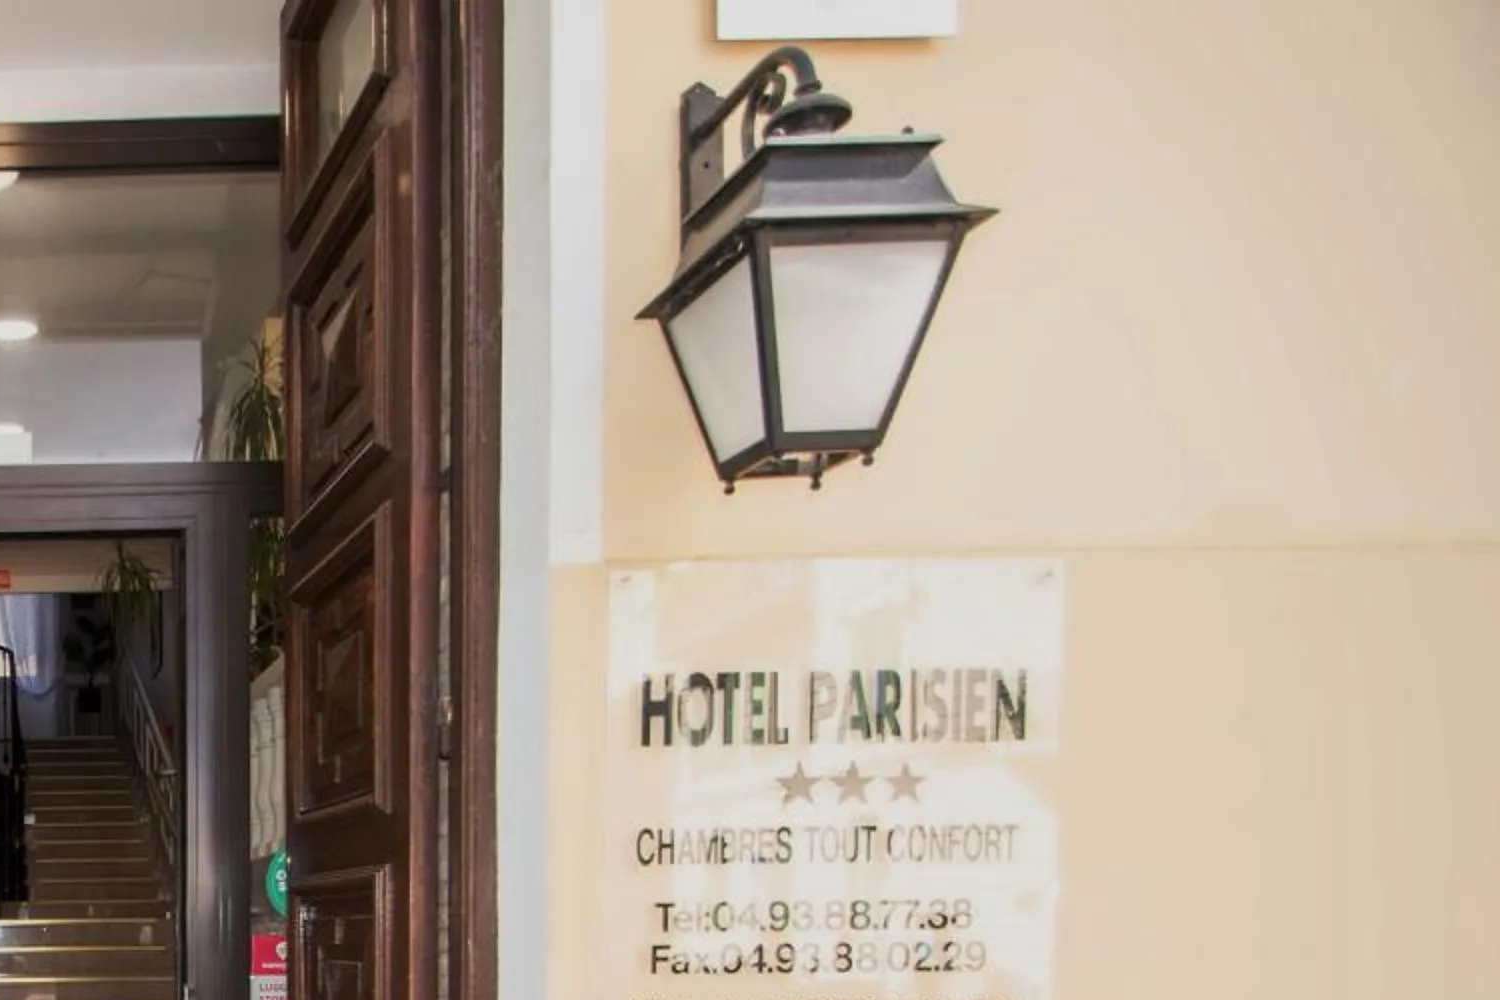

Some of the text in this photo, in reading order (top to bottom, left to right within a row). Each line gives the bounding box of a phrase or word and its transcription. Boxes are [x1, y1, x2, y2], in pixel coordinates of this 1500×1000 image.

[640, 668, 1028, 747] HOTEL PARISIEN
[636, 824, 1020, 866] CHAMBRES TOUT CONFORT
[650, 942, 987, 974] Fax.04.93.8802.29
